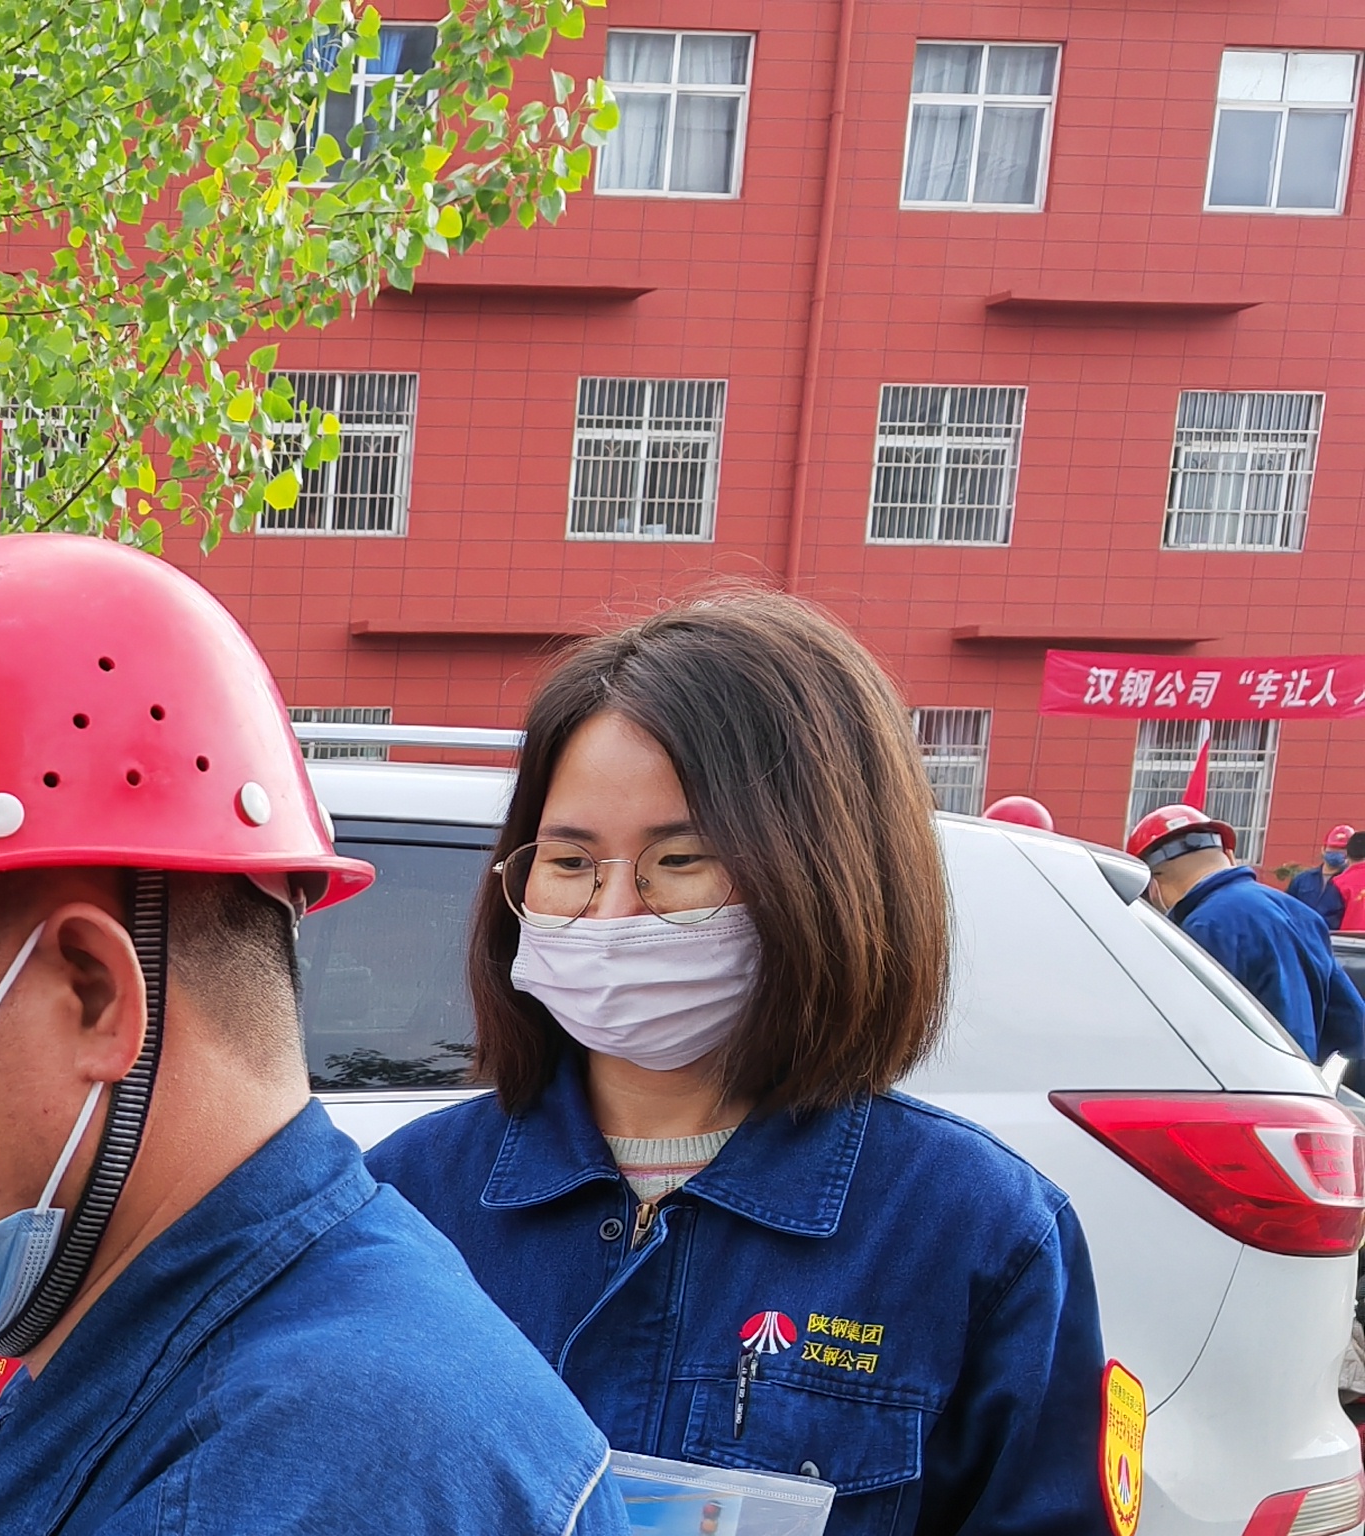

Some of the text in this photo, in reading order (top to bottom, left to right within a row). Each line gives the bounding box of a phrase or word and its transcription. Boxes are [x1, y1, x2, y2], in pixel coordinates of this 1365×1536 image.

[1083, 666, 1221, 709] 汉钢公司
[1238, 668, 1337, 709] “车让人
[807, 1313, 885, 1346] 陕钢集团
[801, 1341, 879, 1374] 汉钢公司
